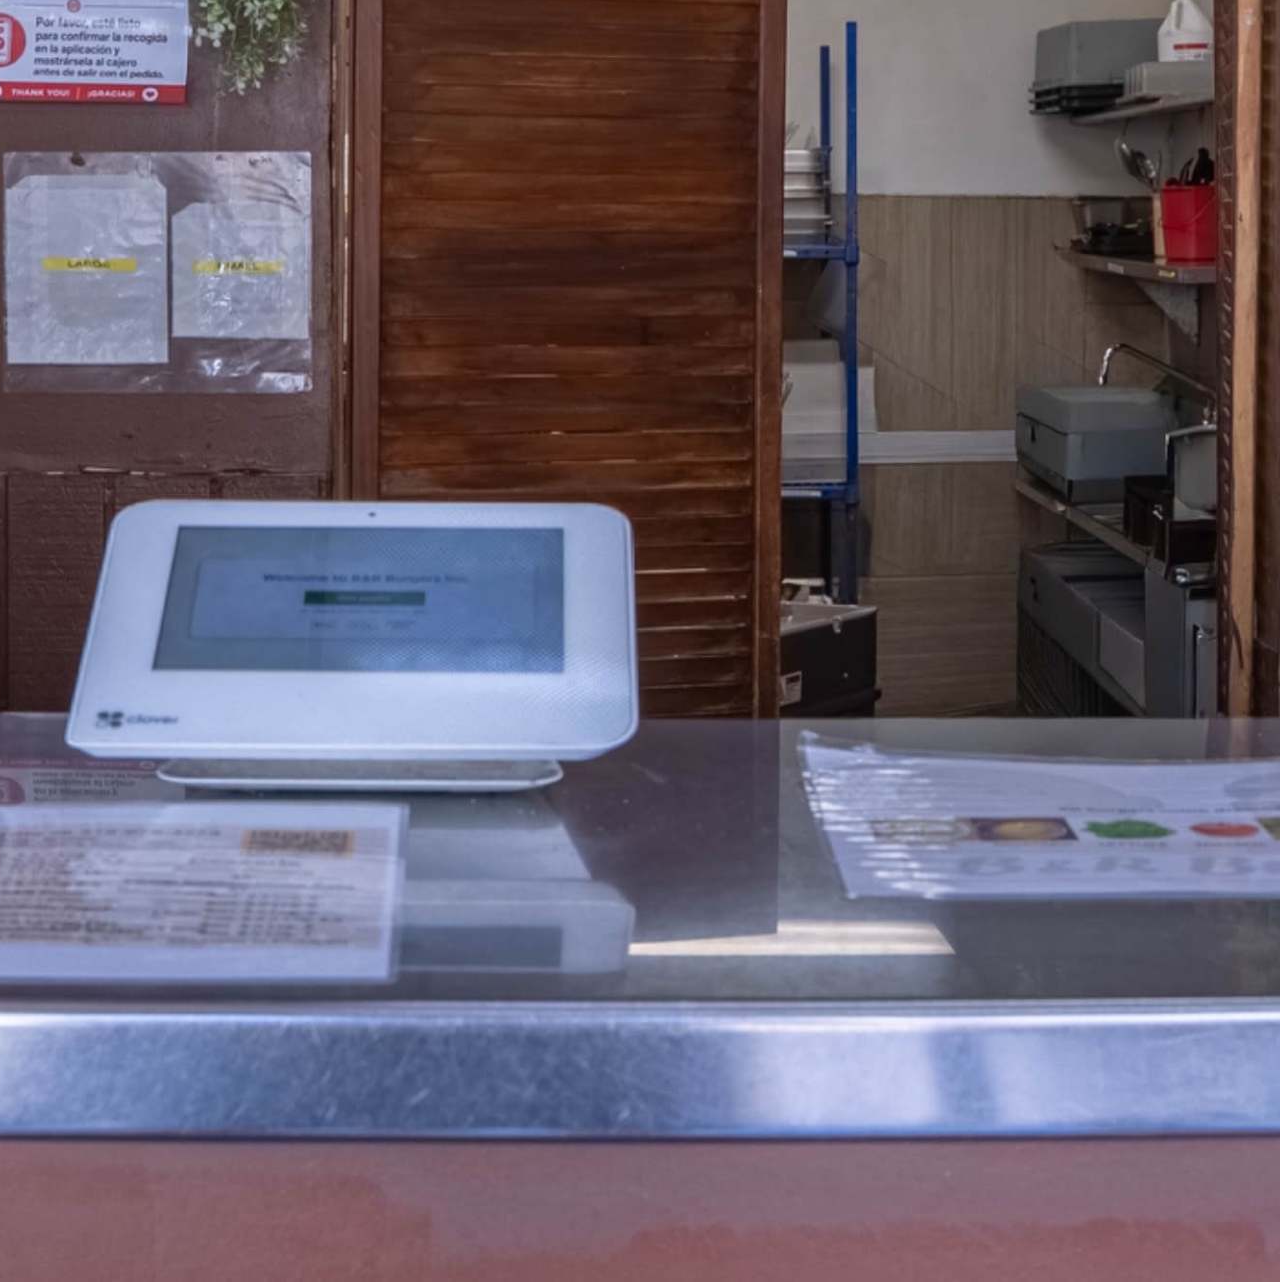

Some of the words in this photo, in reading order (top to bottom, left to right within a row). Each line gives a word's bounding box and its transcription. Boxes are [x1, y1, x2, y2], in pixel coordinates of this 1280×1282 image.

[35, 16, 55, 28] Por
[35, 32, 59, 43] para
[61, 31, 111, 43] confirmar
[112, 32, 121, 43] la
[123, 33, 168, 45] recogida
[34, 46, 48, 54] en
[50, 45, 59, 54] la
[61, 45, 112, 56] aplicación
[113, 47, 121, 57] y
[33, 56, 93, 67] mostrársela
[95, 57, 105, 67] al
[106, 58, 138, 69] cajero
[32, 68, 61, 78] antes
[62, 68, 76, 78] de
[77, 68, 98, 78] salir
[100, 70, 118, 78] con
[119, 69, 128, 78] el
[11, 88, 45, 97] THANK
[262, 573, 329, 584] Welcome
[127, 714, 178, 725] clover
